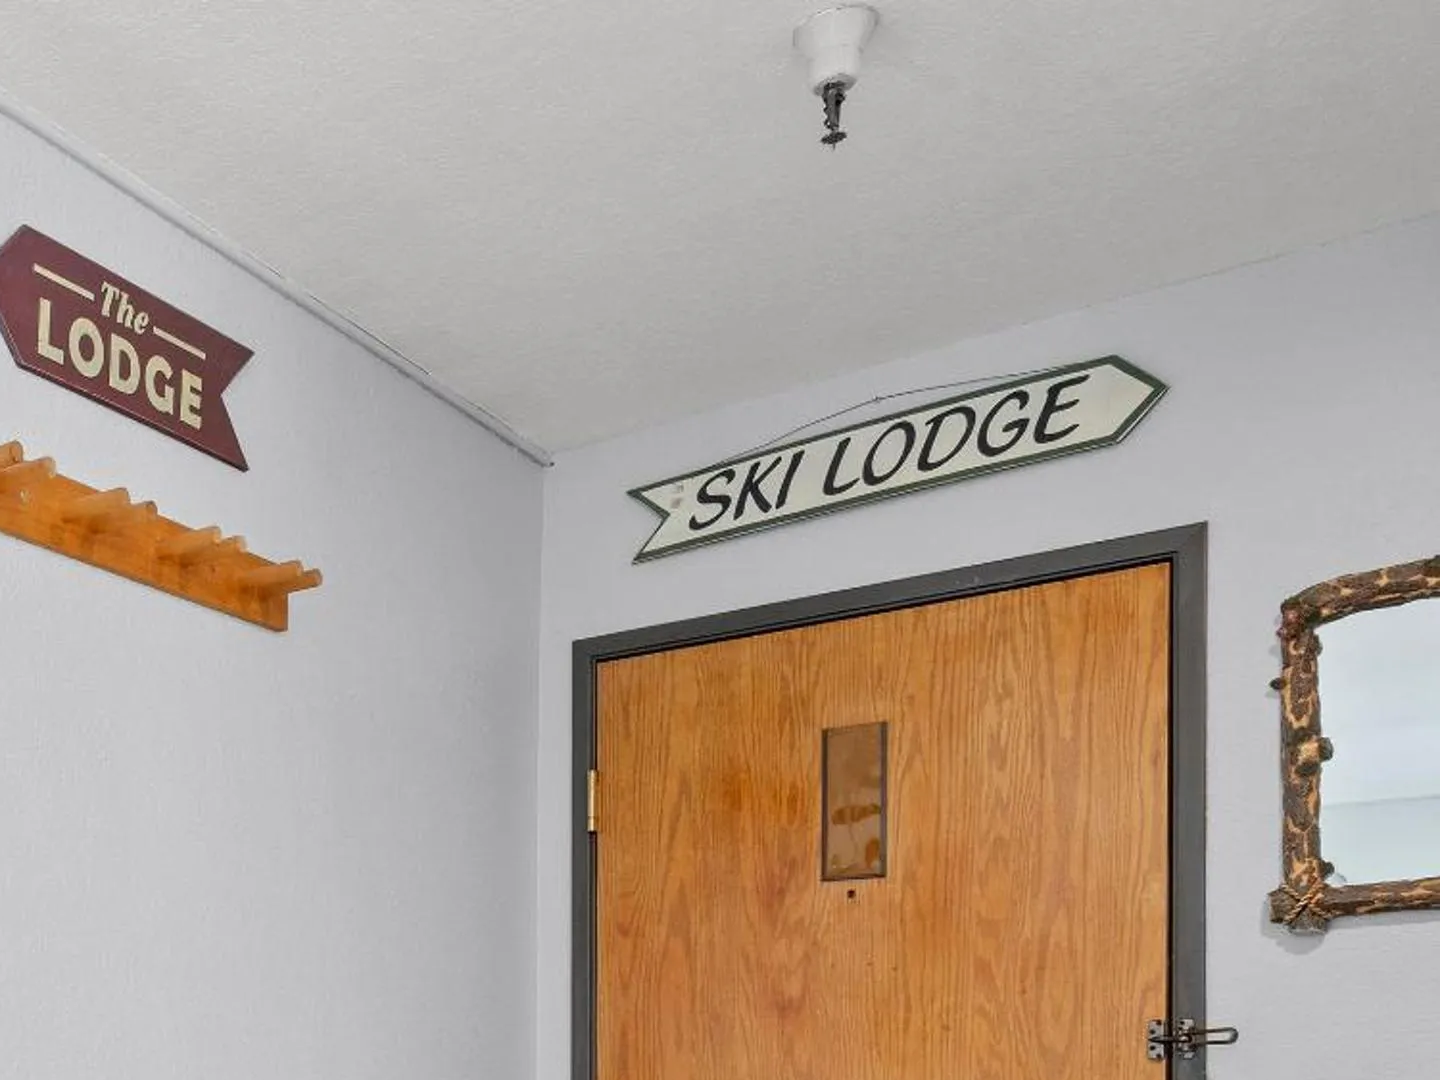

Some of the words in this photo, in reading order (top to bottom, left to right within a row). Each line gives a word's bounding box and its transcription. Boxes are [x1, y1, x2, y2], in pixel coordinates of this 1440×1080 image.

[37, 297, 202, 429] LODGE
[100, 281, 149, 334] The
[689, 450, 804, 531] SKI
[822, 374, 1090, 496] LODGE
